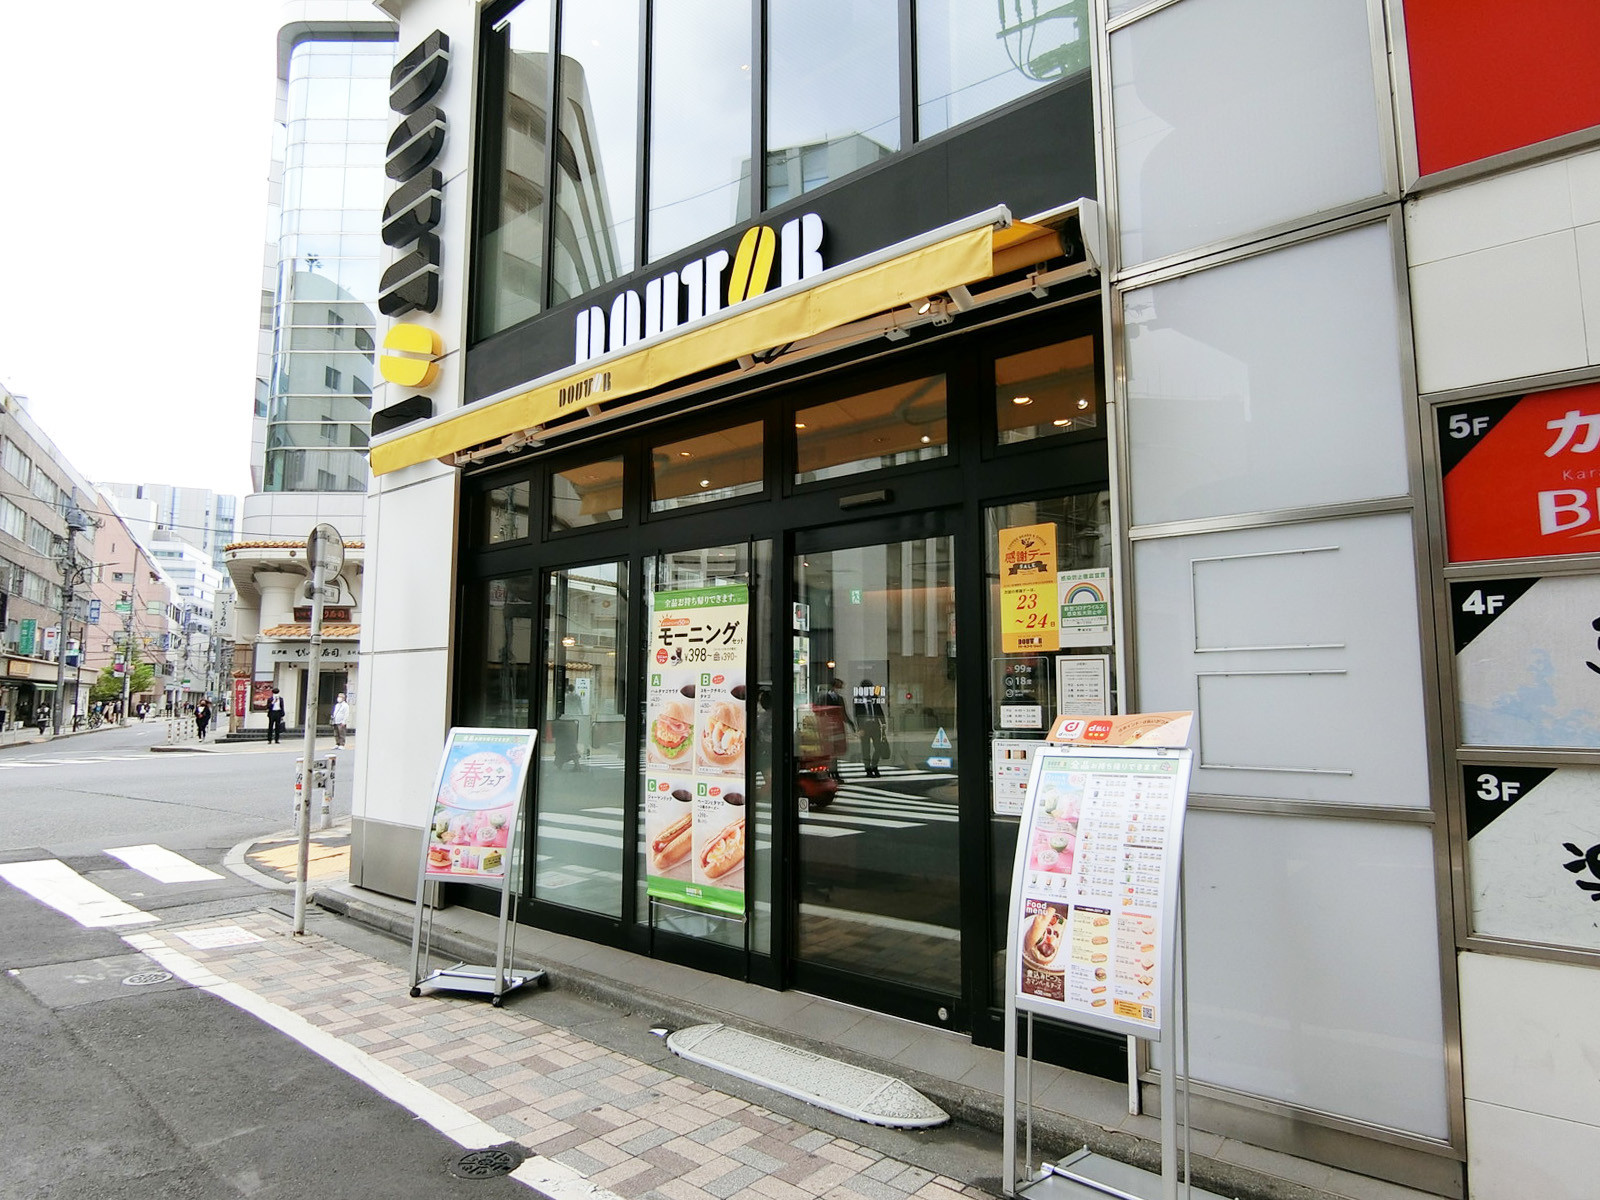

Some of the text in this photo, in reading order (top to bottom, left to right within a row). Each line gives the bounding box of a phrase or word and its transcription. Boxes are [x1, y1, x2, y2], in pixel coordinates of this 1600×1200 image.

[575, 212, 826, 365] DOUTOR
[559, 372, 611, 407] DOUTOR
[1449, 413, 1490, 439] 5F
[1563, 469, 1600, 481] Kar
[1538, 488, 1600, 536] B
[1005, 548, 1050, 564] 感謝デー
[1016, 593, 1037, 610] 23
[1461, 589, 1505, 615] 4F
[658, 621, 740, 646] モーニング
[653, 674, 660, 686] A
[702, 674, 709, 685] B
[853, 685, 886, 697] DOUTOR
[456, 759, 485, 788] 春
[479, 775, 506, 787] フェア
[649, 780, 655, 791] C
[699, 784, 706, 795] D
[1476, 773, 1521, 802] 3F
[1025, 907, 1048, 916] menu
[1026, 899, 1047, 910] Food
